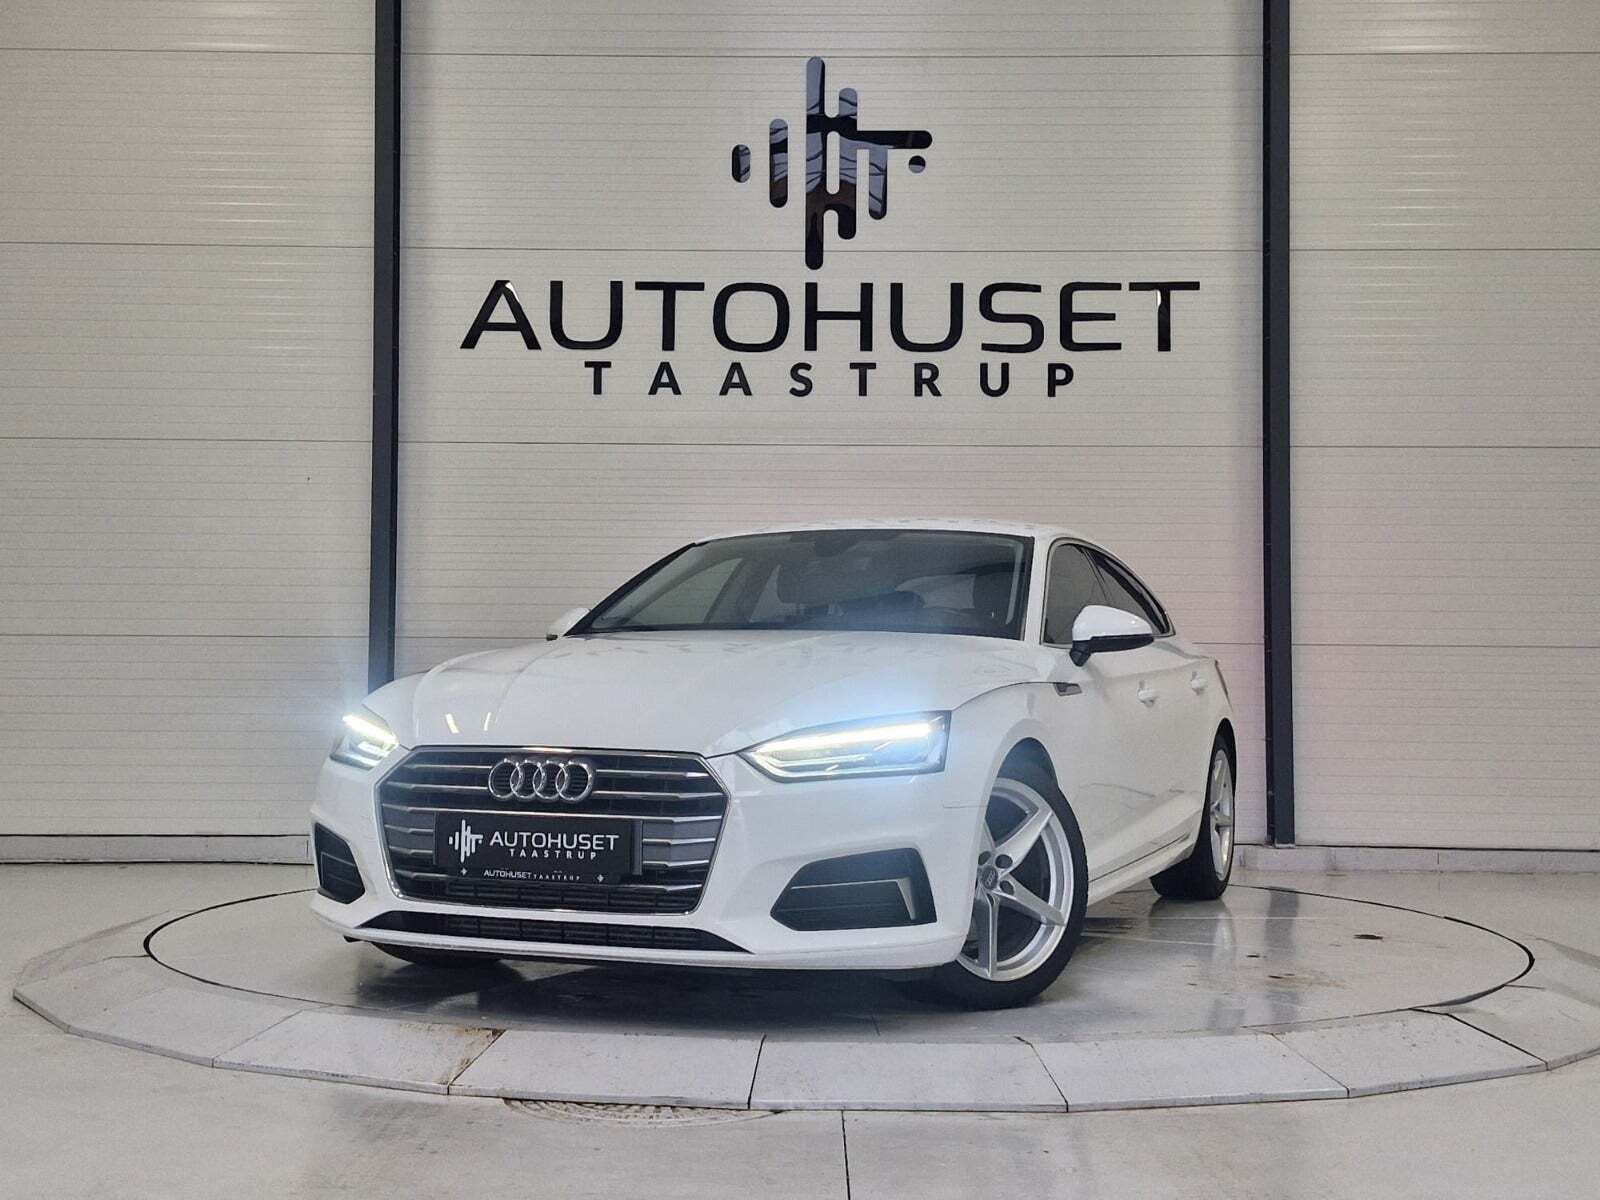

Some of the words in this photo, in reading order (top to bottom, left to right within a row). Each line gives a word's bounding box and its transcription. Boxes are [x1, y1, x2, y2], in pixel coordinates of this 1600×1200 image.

[459, 279, 1201, 353] AUTOHUSET
[584, 361, 1075, 398] TAASTRUP
[489, 831, 620, 851] AUTOHUSET
[510, 849, 598, 860] TAASTRUP
[483, 869, 532, 879] AUTOHUSET
